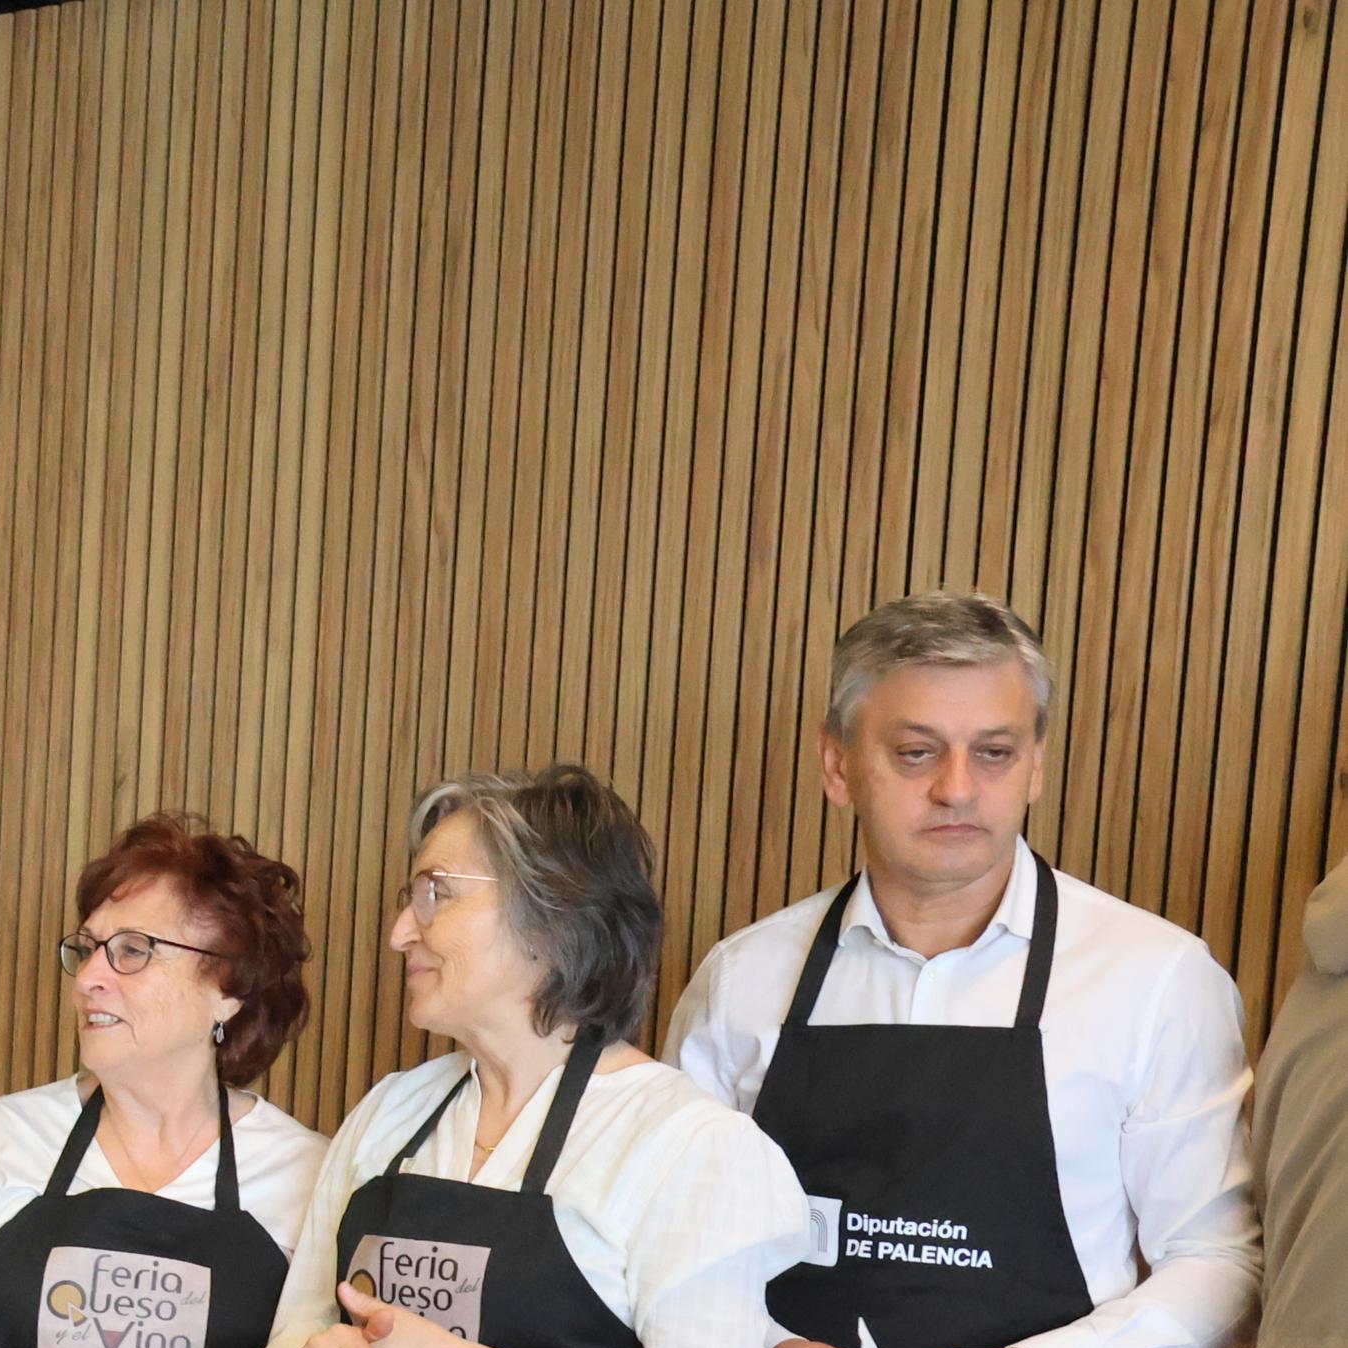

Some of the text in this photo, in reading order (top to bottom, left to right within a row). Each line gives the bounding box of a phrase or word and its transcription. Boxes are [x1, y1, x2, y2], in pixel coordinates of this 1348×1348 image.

[846, 1212, 968, 1240] Diputación
[845, 1239, 994, 1269] DE PALENCIA
